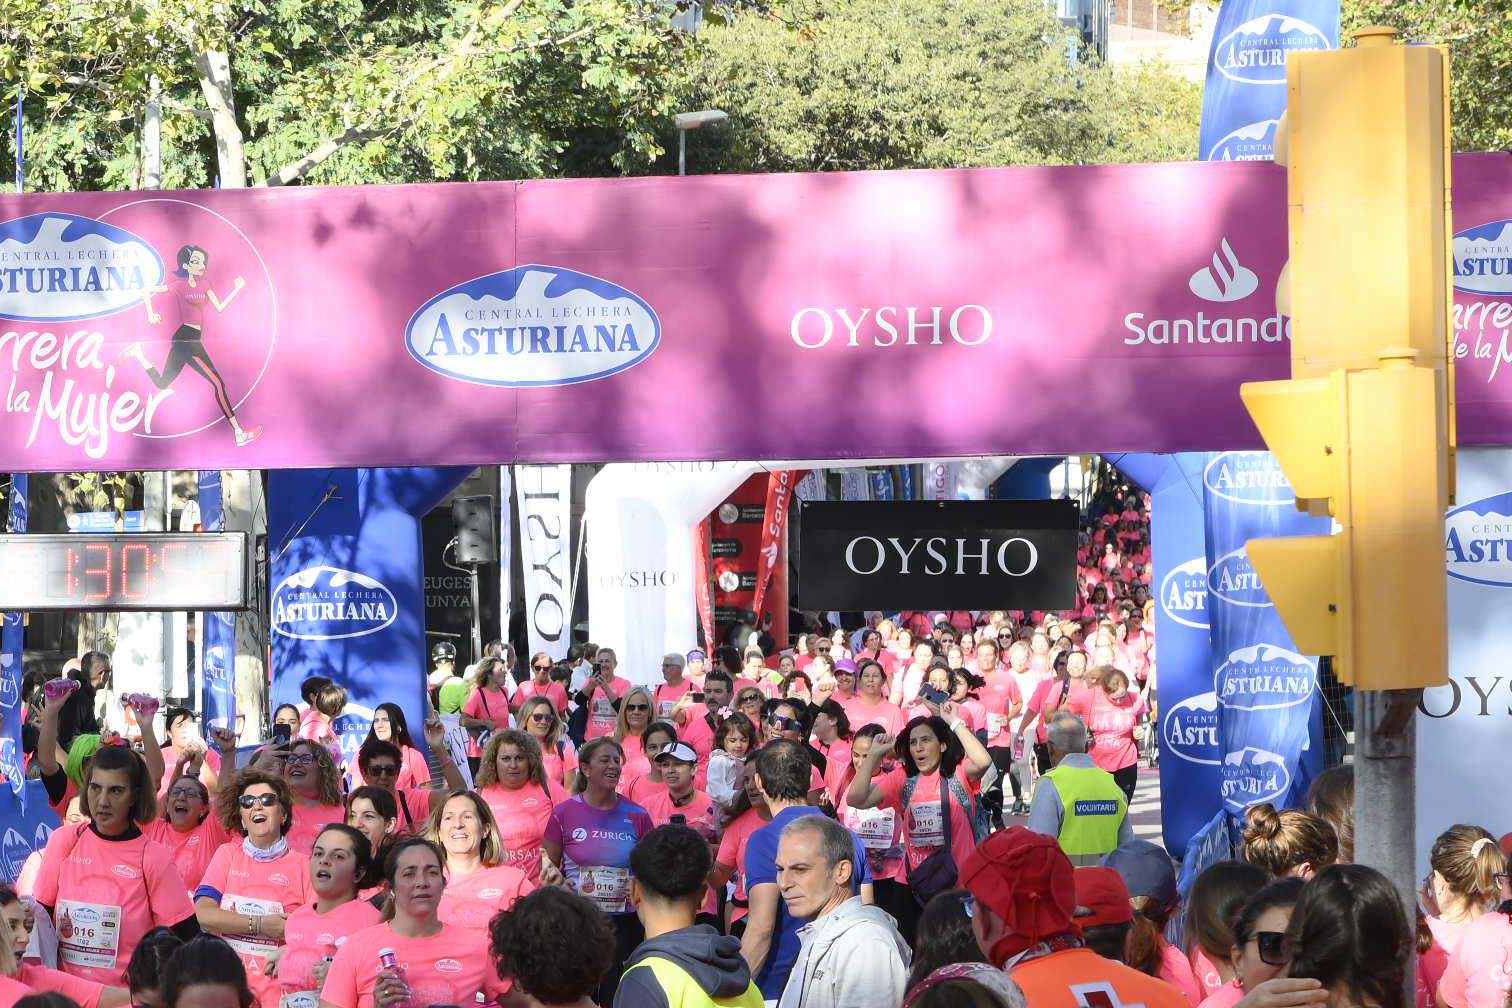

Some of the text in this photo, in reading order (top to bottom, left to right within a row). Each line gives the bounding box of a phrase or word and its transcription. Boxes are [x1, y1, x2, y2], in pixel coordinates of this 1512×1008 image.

[1224, 44, 1290, 69] ASTURI
[464, 306, 633, 321] CENTRAL LECHERA
[790, 304, 994, 348] OYSHO
[425, 312, 642, 357] ASTURIANA
[1123, 311, 1292, 346] Santand
[5, 376, 31, 412] la
[26, 369, 177, 458] Mujer
[844, 535, 1040, 577] OYSHO
[287, 590, 385, 600] CENTRAL LECHERA
[274, 598, 389, 624] ASTURIANA
[591, 830, 632, 841] ZURICH
[73, 926, 95, 938] 016
